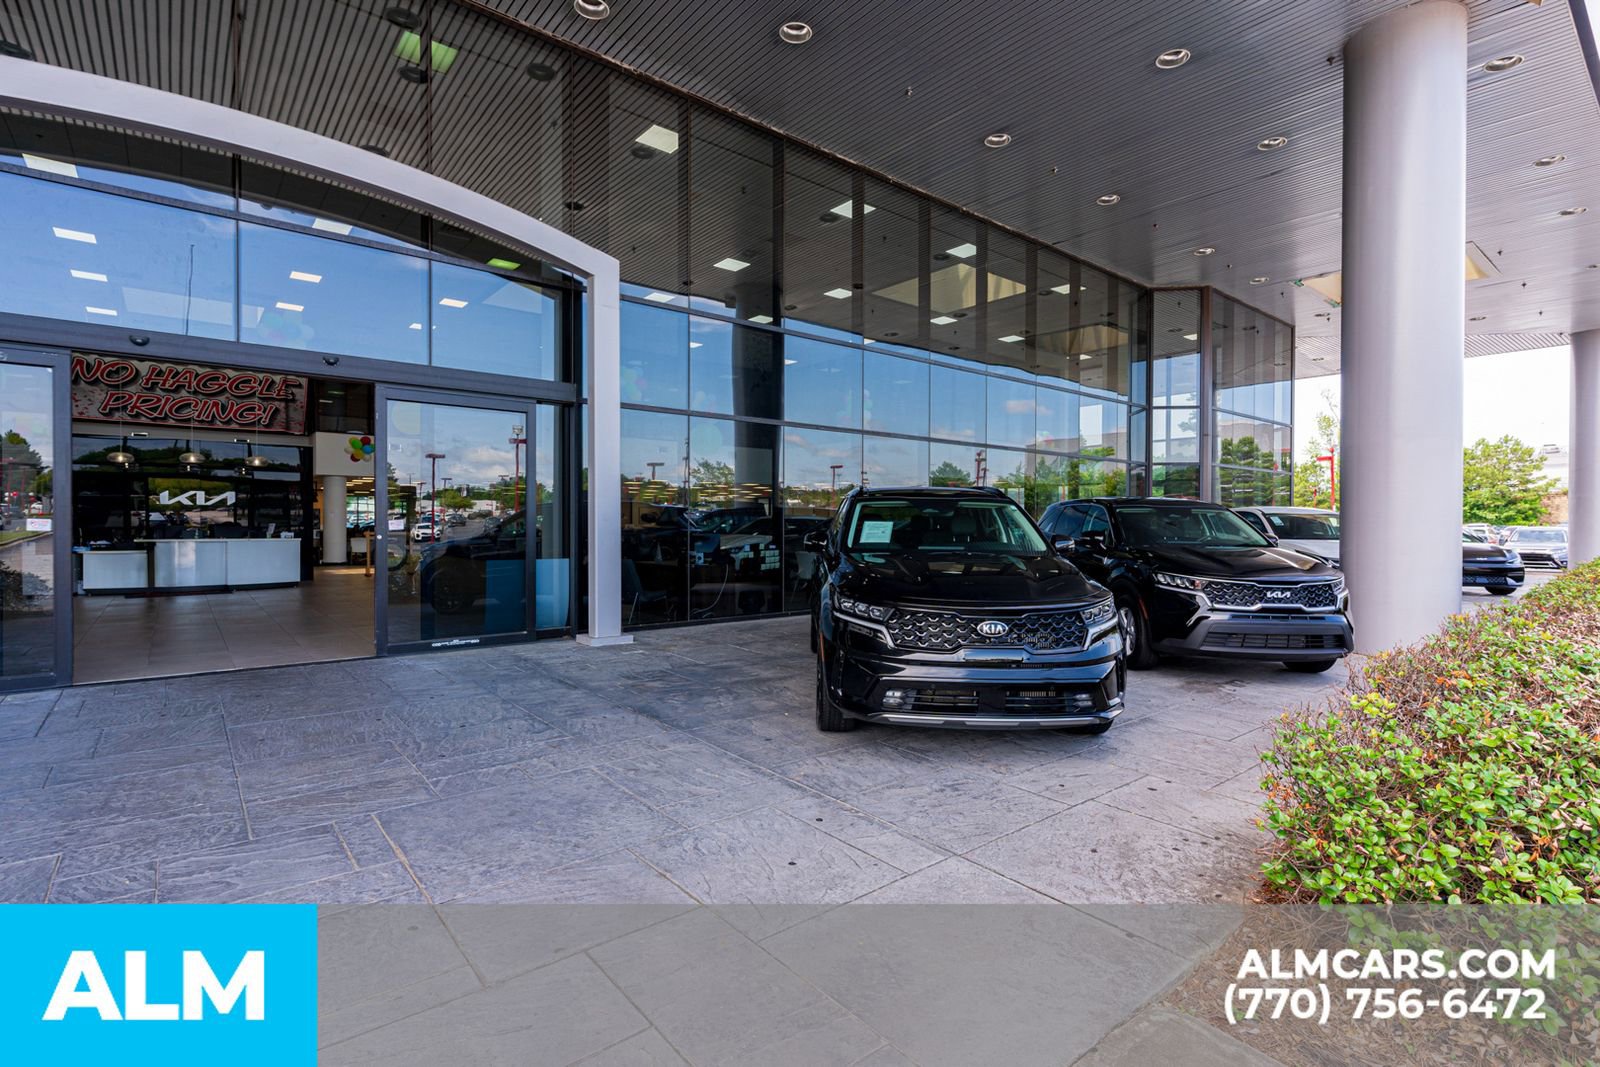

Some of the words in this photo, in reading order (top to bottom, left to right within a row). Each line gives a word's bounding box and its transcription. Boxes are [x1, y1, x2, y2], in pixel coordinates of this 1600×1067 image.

[72, 357, 137, 384] NO
[141, 365, 300, 399] HAGGLE
[99, 391, 276, 424] PRICING!
[160, 490, 236, 505] KIA
[982, 624, 1004, 634] KIA
